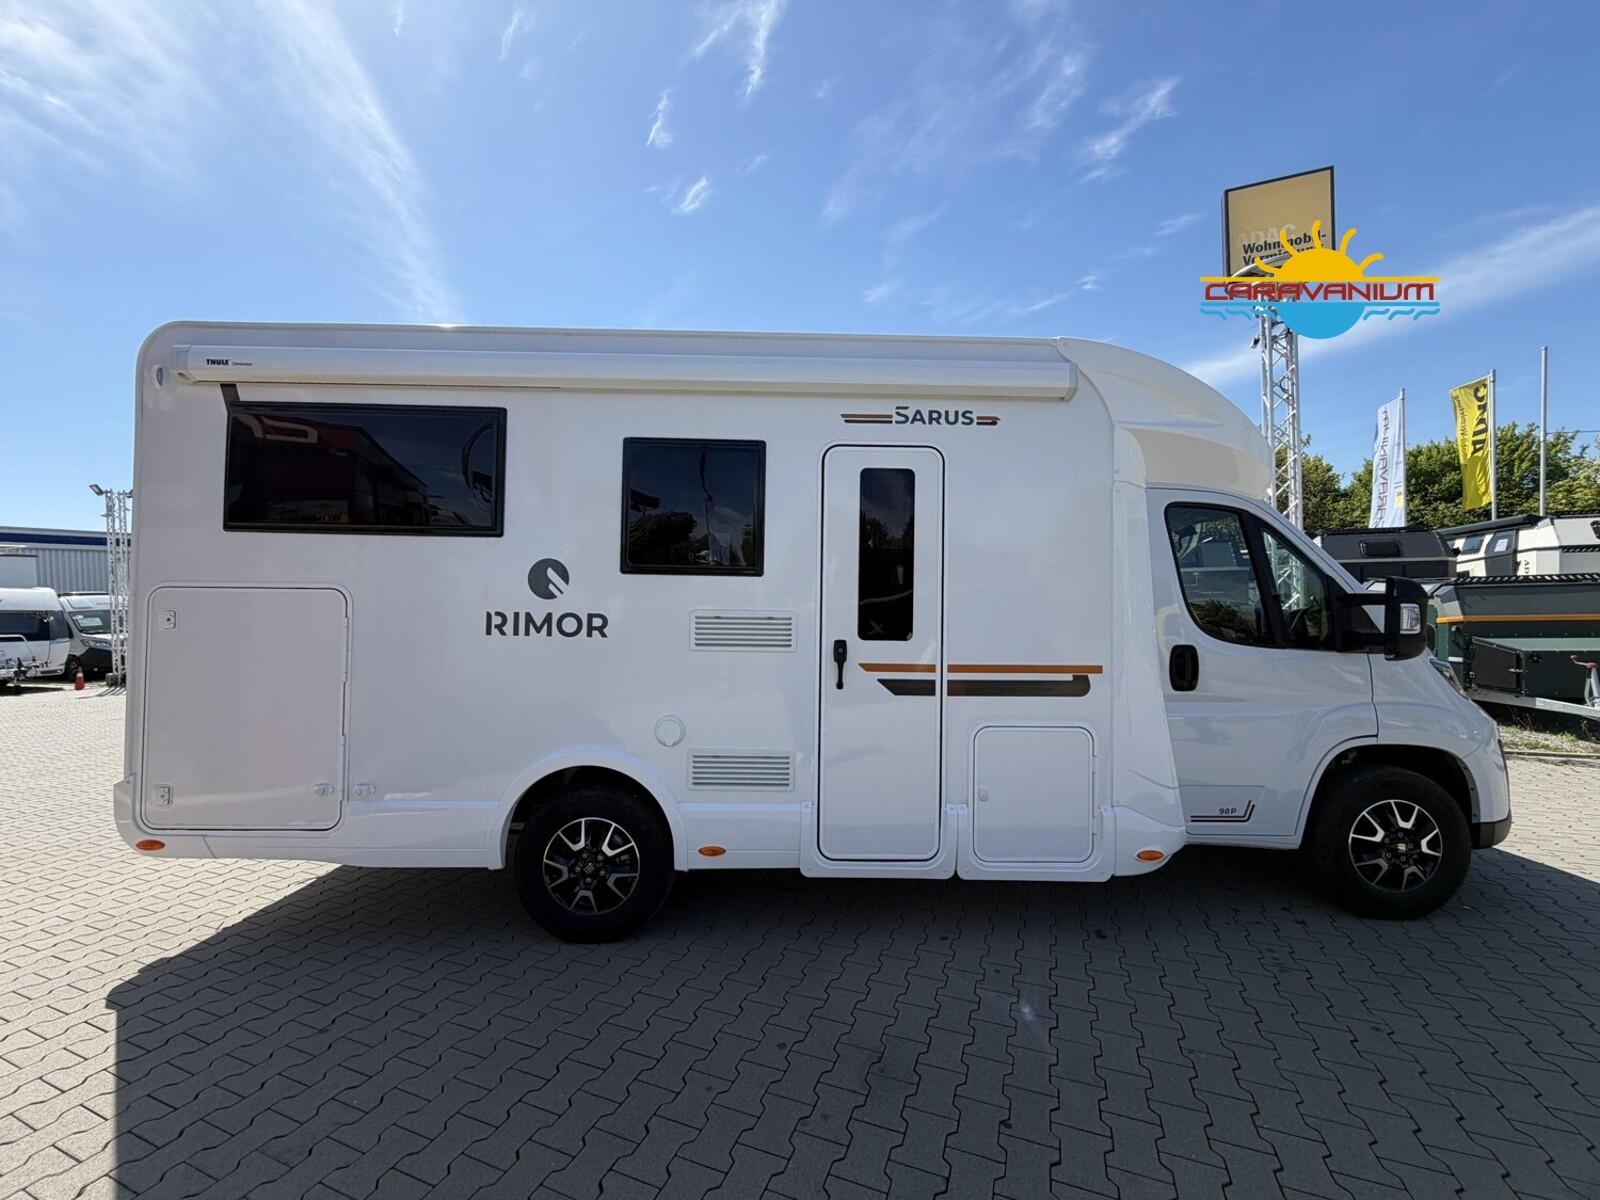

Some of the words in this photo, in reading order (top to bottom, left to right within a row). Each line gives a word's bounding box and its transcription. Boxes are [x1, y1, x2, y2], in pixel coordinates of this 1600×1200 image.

[205, 358, 231, 366] THULE
[894, 405, 975, 426] SARUS
[485, 610, 609, 639] RIMOR
